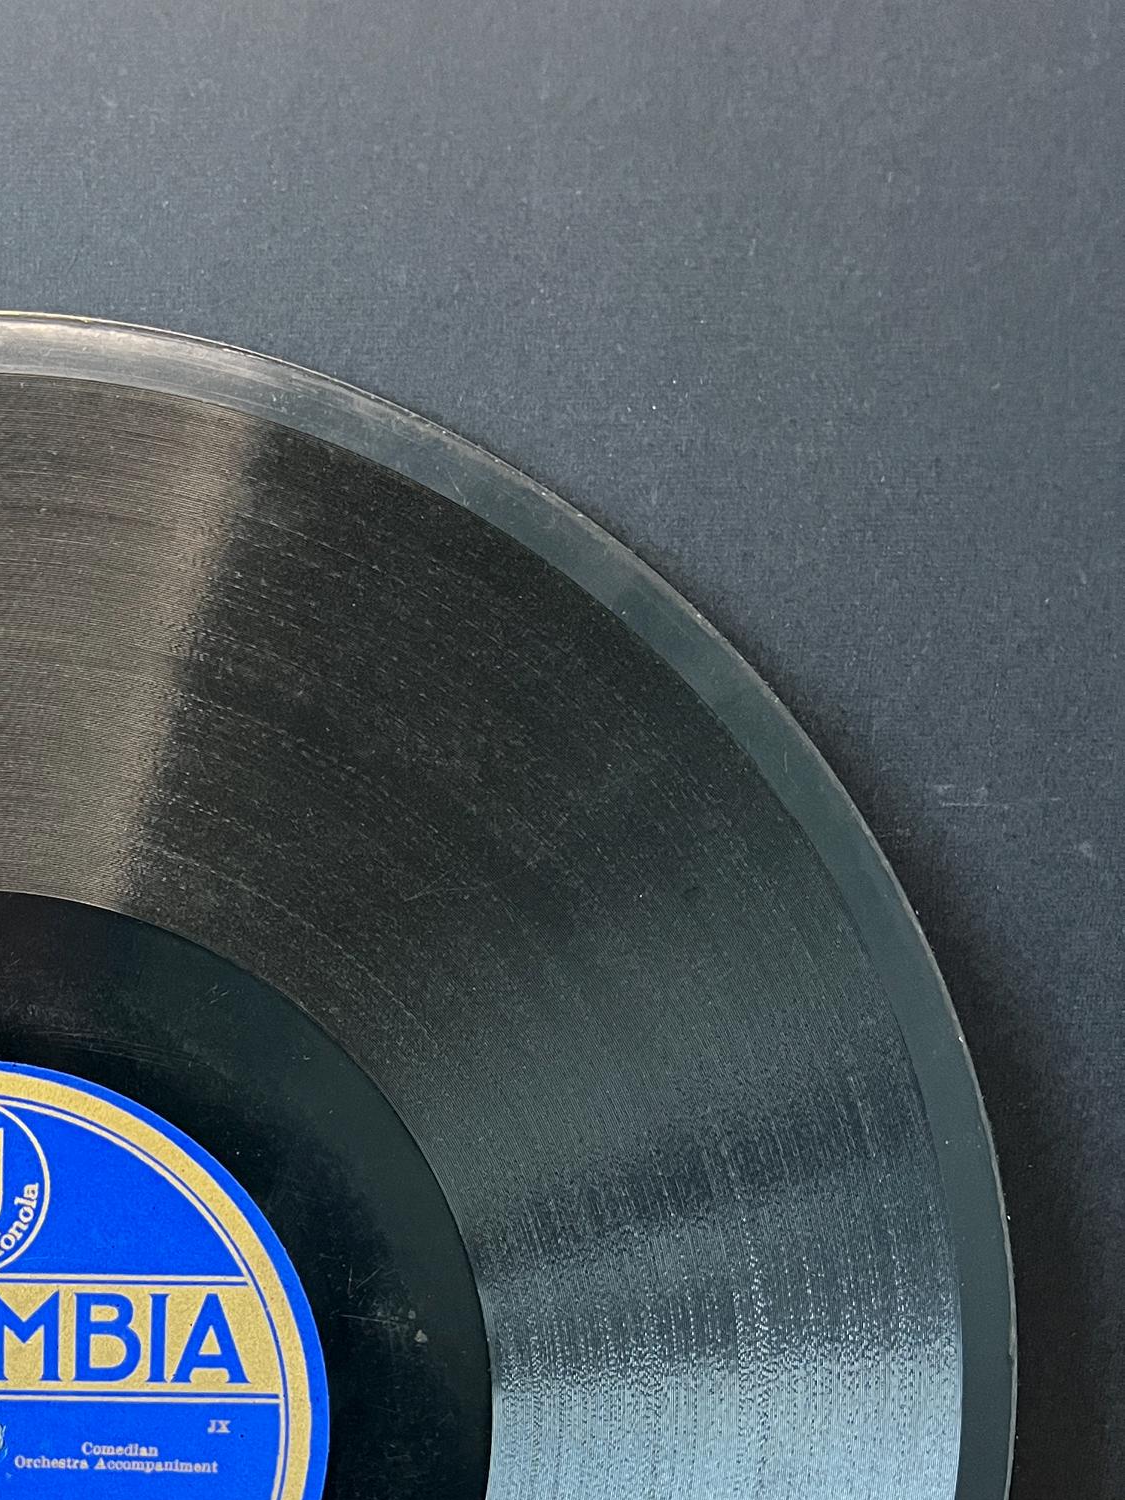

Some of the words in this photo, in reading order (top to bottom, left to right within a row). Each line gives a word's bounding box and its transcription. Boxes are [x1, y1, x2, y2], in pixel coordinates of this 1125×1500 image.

[207, 1420, 230, 1433] JX
[81, 1442, 158, 1457] Comedian
[14, 1456, 89, 1470] Orchestra
[95, 1458, 218, 1474] Accompaniment
